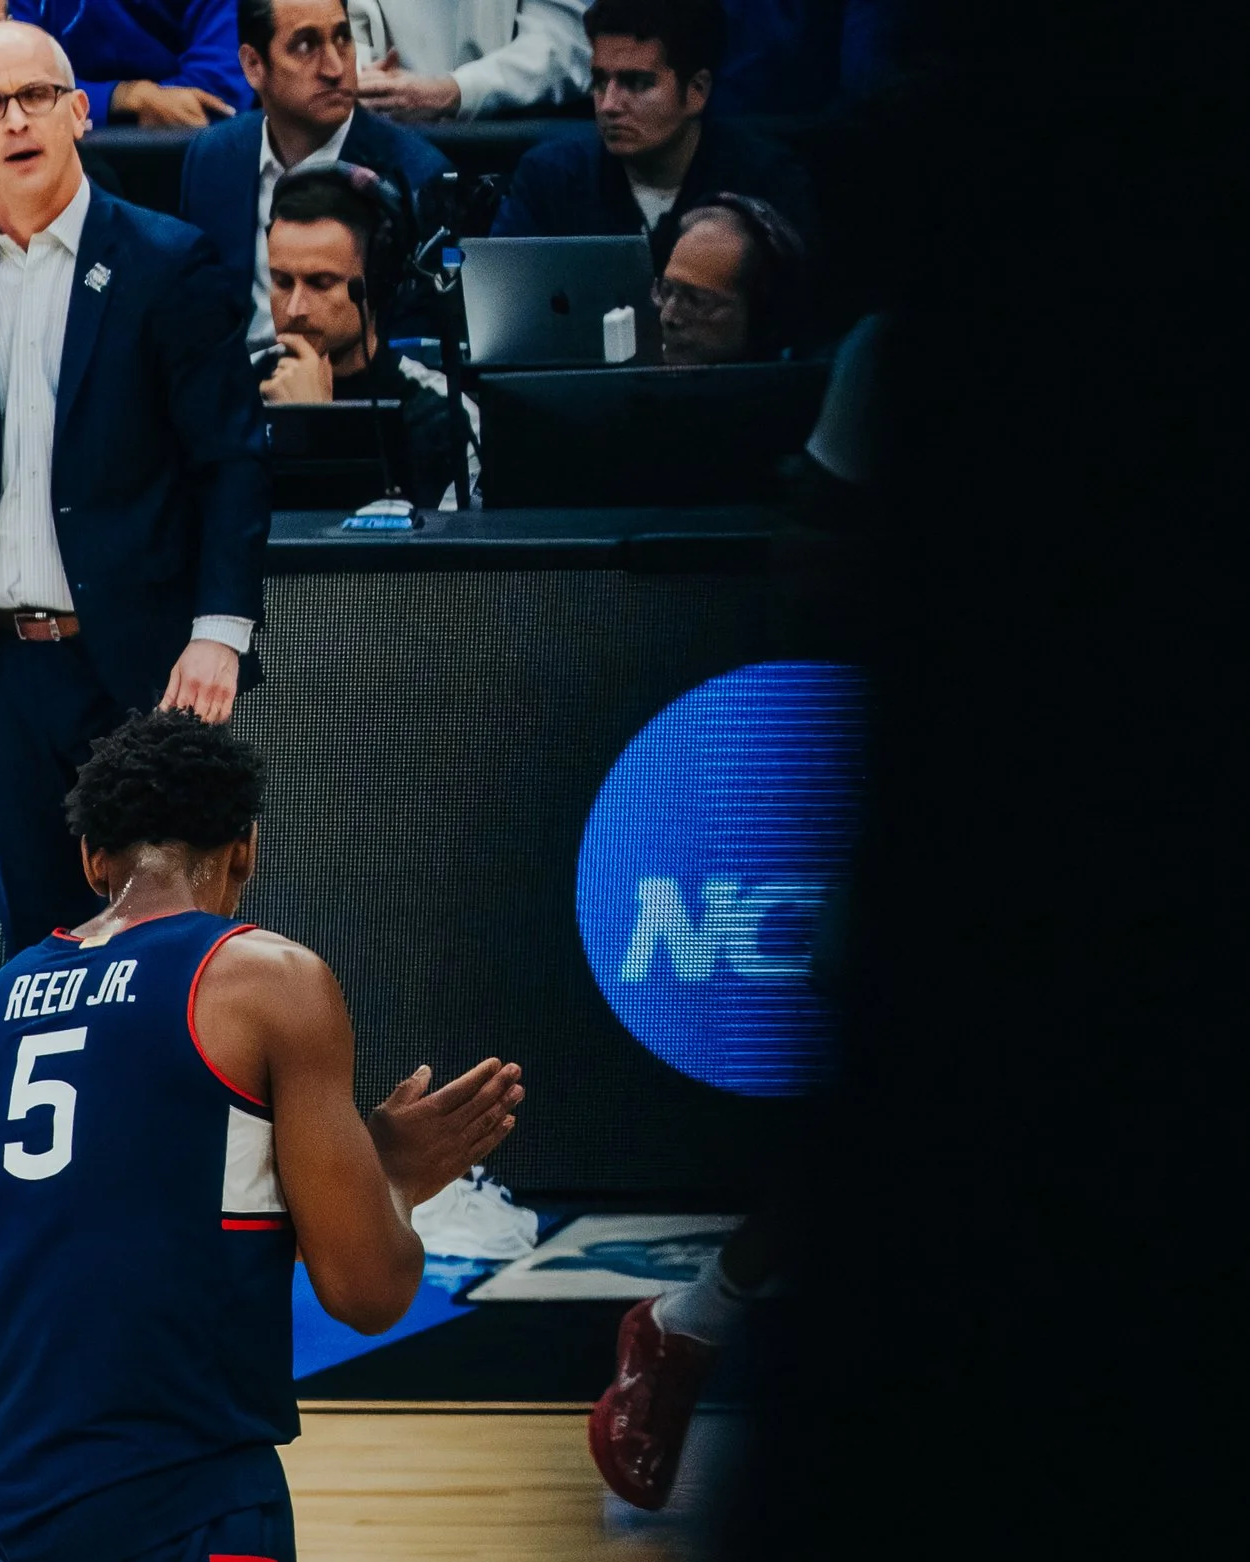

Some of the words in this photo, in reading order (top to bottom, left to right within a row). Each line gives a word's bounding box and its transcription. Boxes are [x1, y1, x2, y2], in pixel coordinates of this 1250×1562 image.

[4, 967, 88, 1021] REED
[86, 959, 138, 1006] JR.
[3, 1026, 88, 1180] 5
